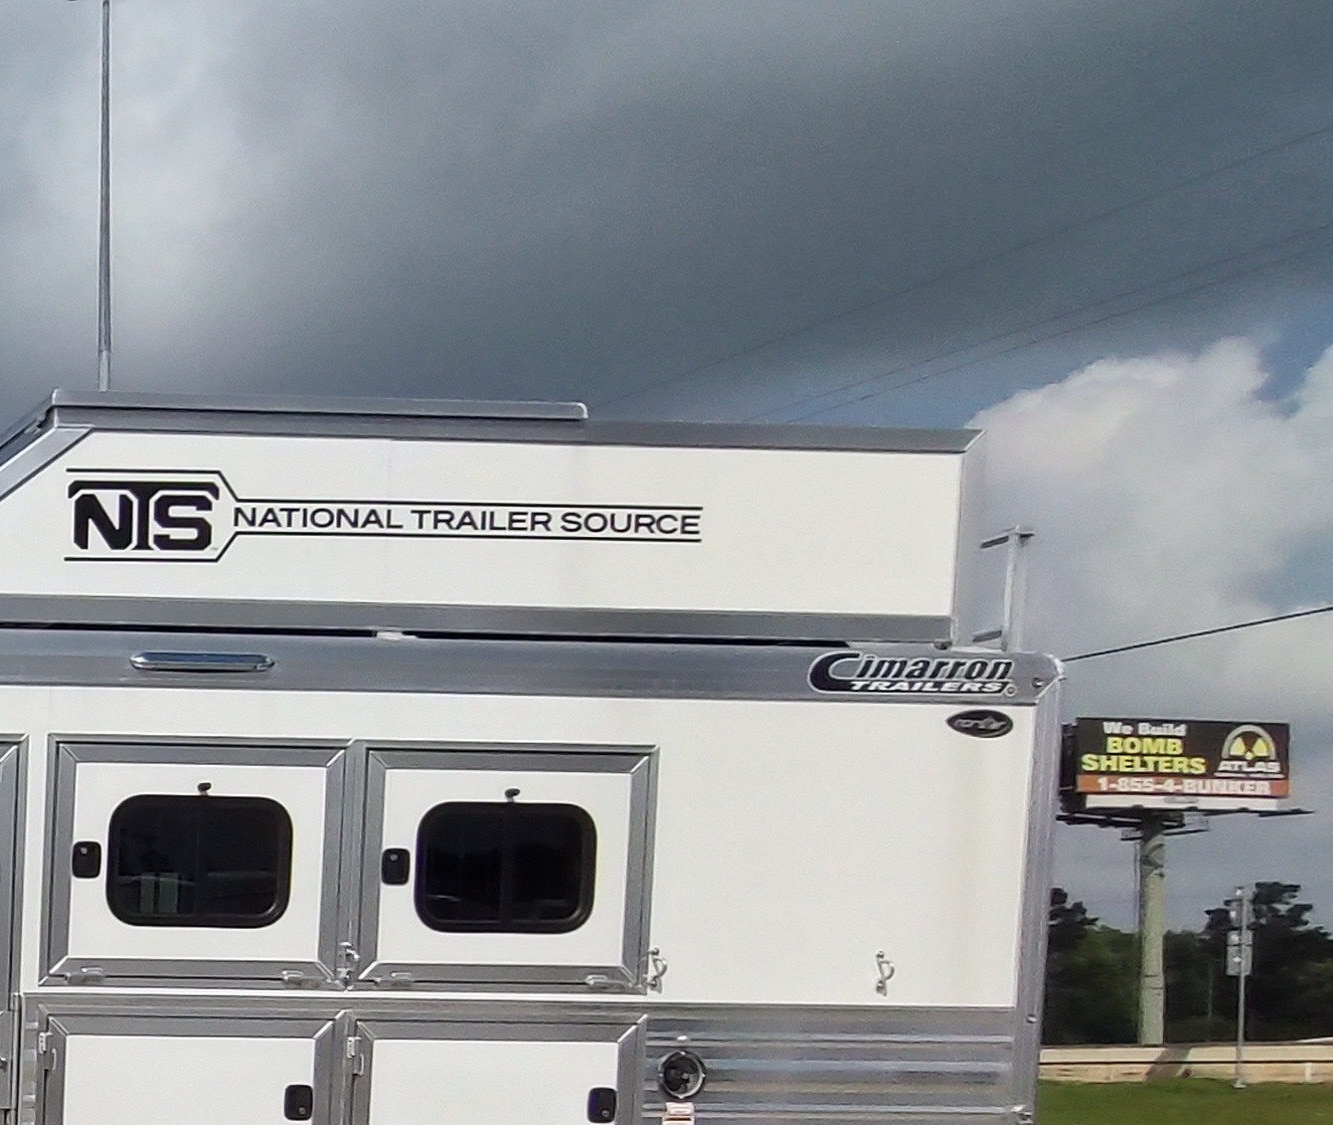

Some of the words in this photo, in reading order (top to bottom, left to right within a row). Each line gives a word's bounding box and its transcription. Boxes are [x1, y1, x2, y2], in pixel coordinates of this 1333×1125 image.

[68, 480, 220, 550] NTS
[233, 506, 404, 530] NATIONAL
[410, 509, 552, 532] TRAILER
[560, 512, 701, 534] SOURCE
[808, 652, 1014, 690] Cimarron
[849, 680, 1004, 693] TRAILERS
[1103, 721, 1134, 735] We
[1138, 723, 1187, 737] Build
[1106, 736, 1183, 755] BOMB
[1082, 754, 1206, 774] SHELTERS
[1217, 760, 1281, 773] ATLAS
